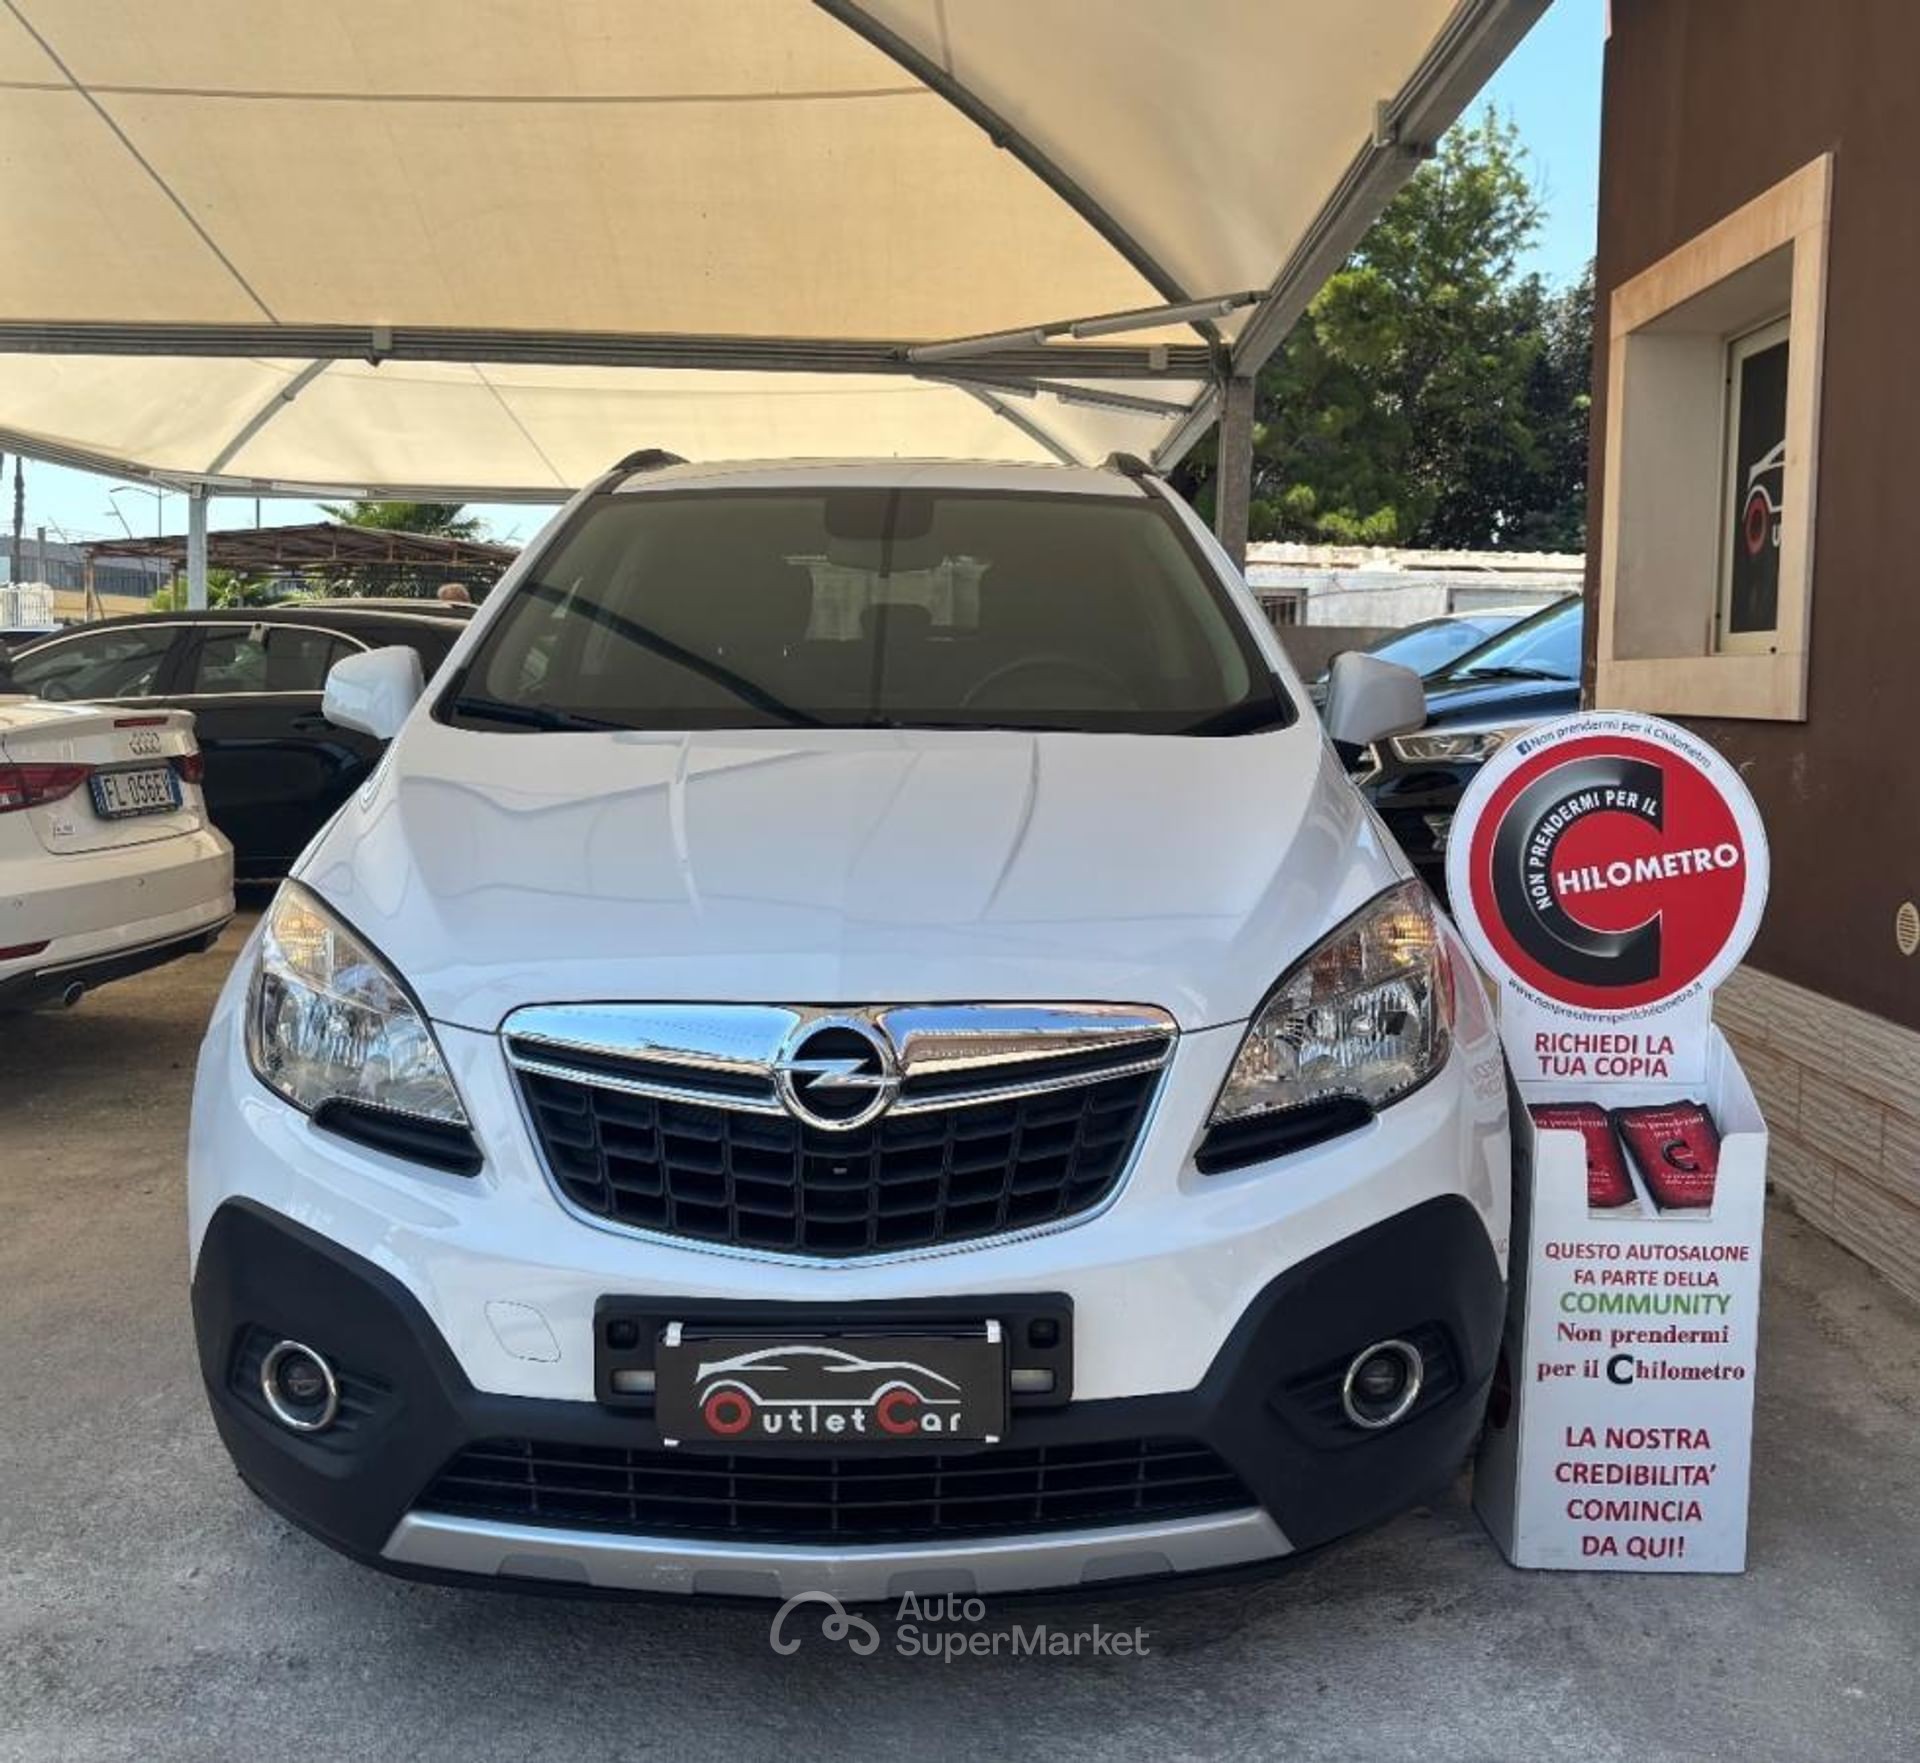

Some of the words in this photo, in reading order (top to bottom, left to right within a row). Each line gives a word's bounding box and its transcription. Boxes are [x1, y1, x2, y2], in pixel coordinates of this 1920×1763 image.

[1531, 733, 1555, 748] Non
[1621, 722, 1641, 734] per
[103, 775, 126, 807] FL
[1605, 789, 1637, 808] PER
[1640, 797, 1658, 817] IL
[1529, 792, 1600, 868] PRENDERMI
[1528, 873, 1553, 911] NON
[1535, 1032, 1638, 1055] RICHIEDI
[1646, 1036, 1674, 1056] LA
[1539, 1056, 1587, 1076] TUA
[1594, 1057, 1669, 1078] COPIA
[1545, 1242, 1620, 1261] QUESTO
[1625, 1244, 1749, 1261] AUTOSALONE
[1574, 1270, 1595, 1285] FA
[1601, 1271, 1657, 1286] PARTE
[1664, 1272, 1719, 1286] DELLA
[1559, 1292, 1731, 1315] COMMUNITY
[1557, 1323, 1601, 1342] Non
[1610, 1325, 1729, 1348] prendermi
[1536, 1361, 1575, 1382] per
[1584, 1358, 1598, 1378] il
[1566, 1427, 1596, 1448] LA
[1605, 1429, 1710, 1449] NOSTRA
[1567, 1500, 1702, 1521] COMINCIA
[1582, 1537, 1618, 1556] DA
[1626, 1537, 1685, 1559] QUI!
